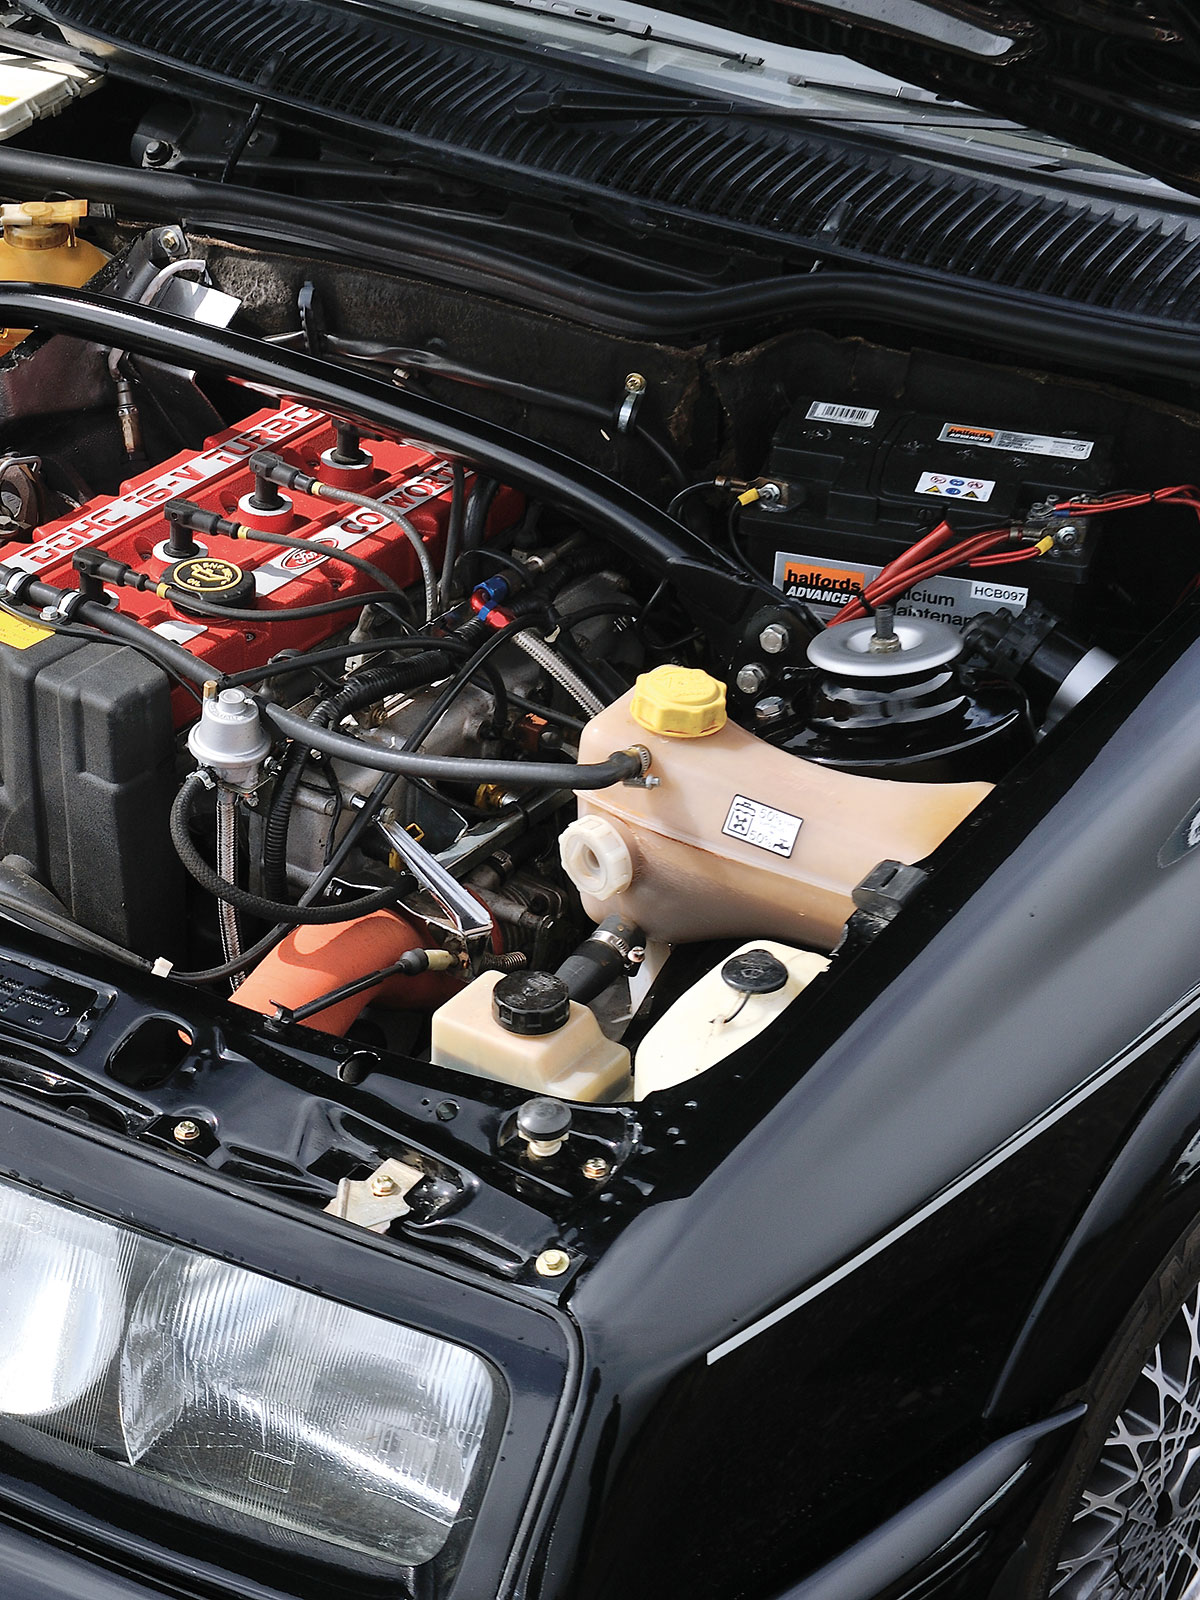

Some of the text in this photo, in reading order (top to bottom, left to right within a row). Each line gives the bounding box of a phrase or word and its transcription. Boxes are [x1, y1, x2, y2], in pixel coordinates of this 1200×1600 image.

[340, 461, 455, 534] COWORT
[20, 508, 130, 564] DOHC
[123, 465, 207, 508] 16-V
[787, 569, 863, 593] halfords
[902, 589, 955, 607] lcium
[974, 586, 1026, 602] HCB097
